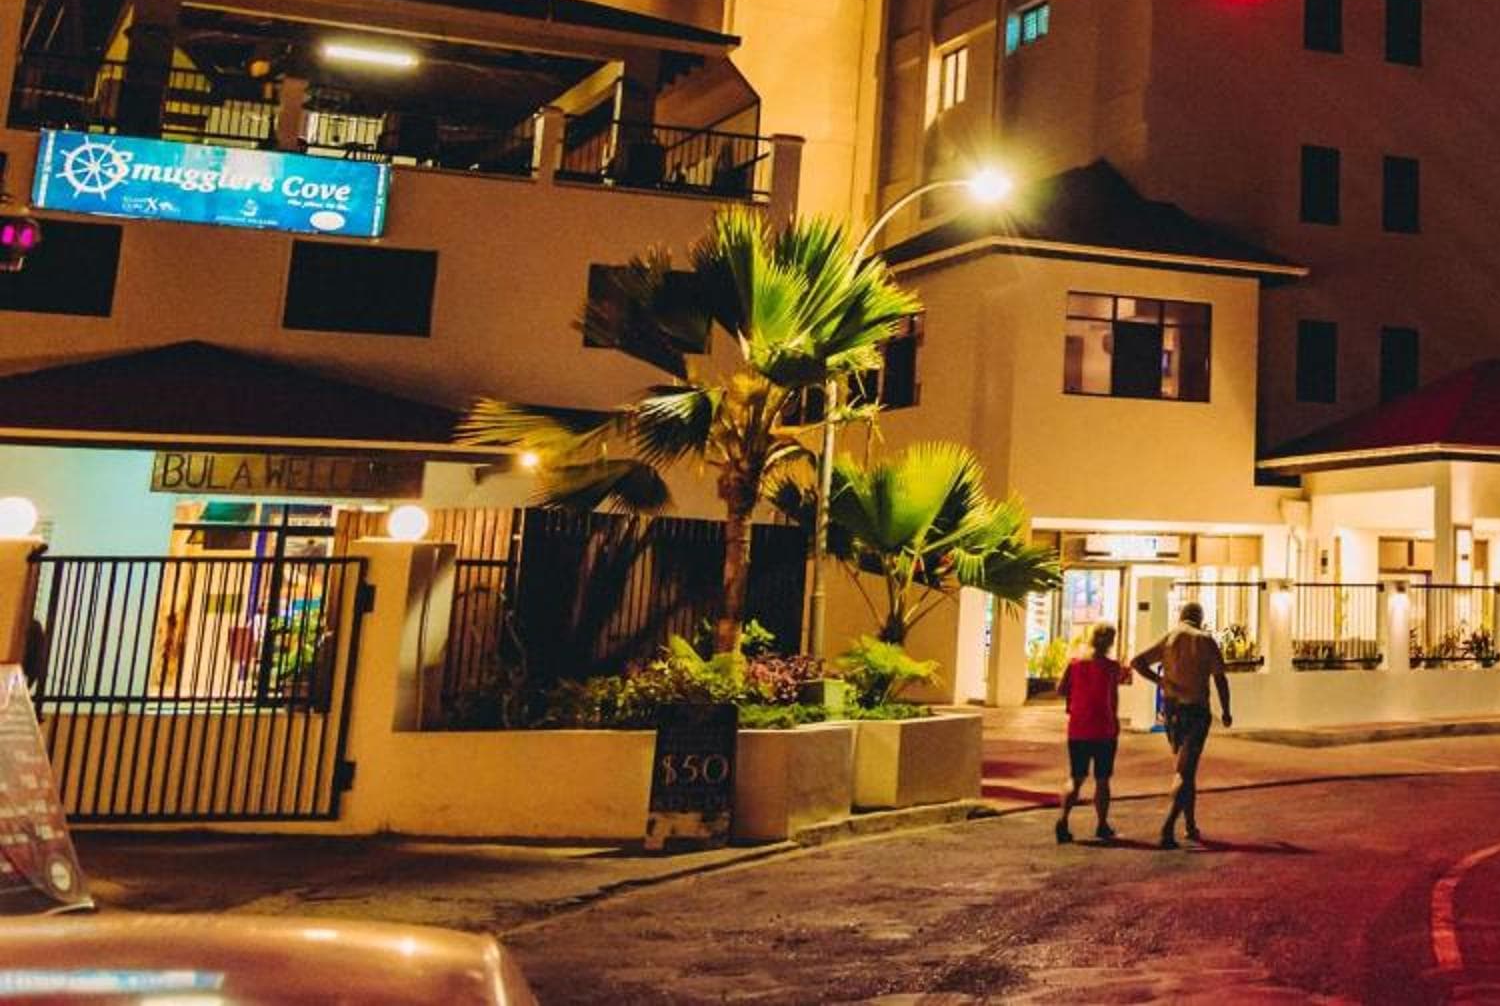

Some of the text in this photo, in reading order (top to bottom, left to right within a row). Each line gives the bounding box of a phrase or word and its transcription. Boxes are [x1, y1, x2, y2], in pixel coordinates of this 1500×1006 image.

[104, 150, 274, 193] Smugglers
[281, 176, 352, 202] Cove
[161, 453, 252, 490] BULA
[662, 754, 730, 787] $50
